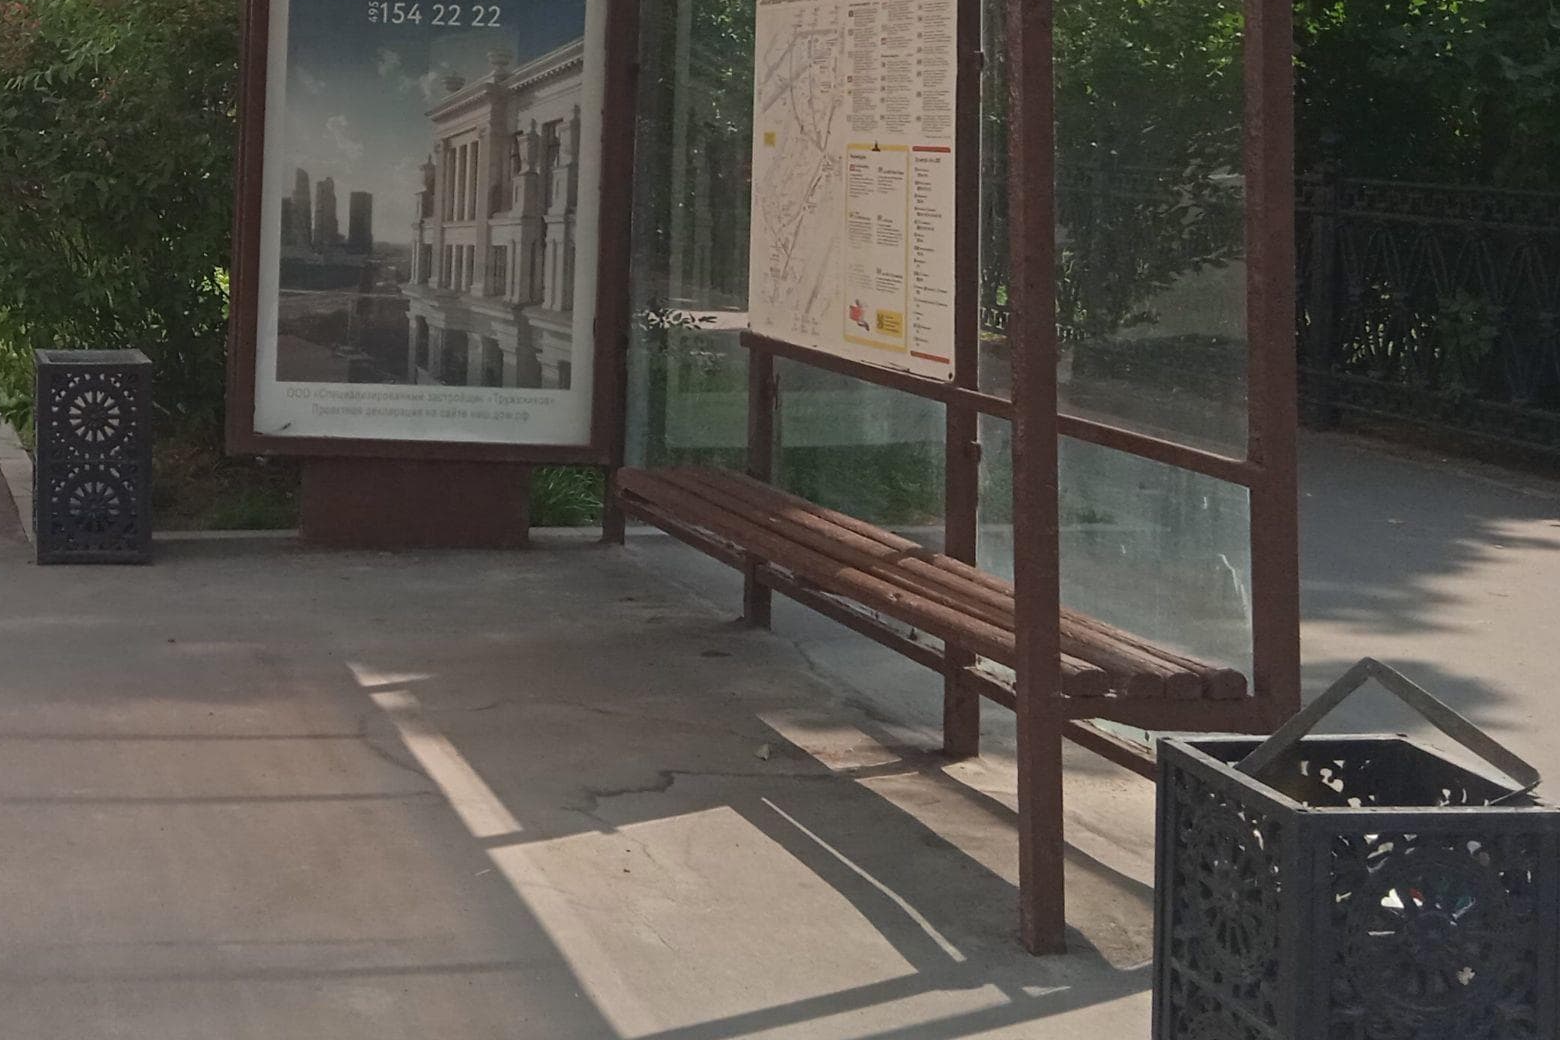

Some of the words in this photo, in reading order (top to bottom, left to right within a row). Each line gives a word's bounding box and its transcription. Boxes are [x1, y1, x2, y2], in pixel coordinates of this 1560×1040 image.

[368, 1, 380, 23] 495
[380, 2, 423, 24] 154
[431, 4, 461, 26] 22
[471, 5, 501, 27] 22
